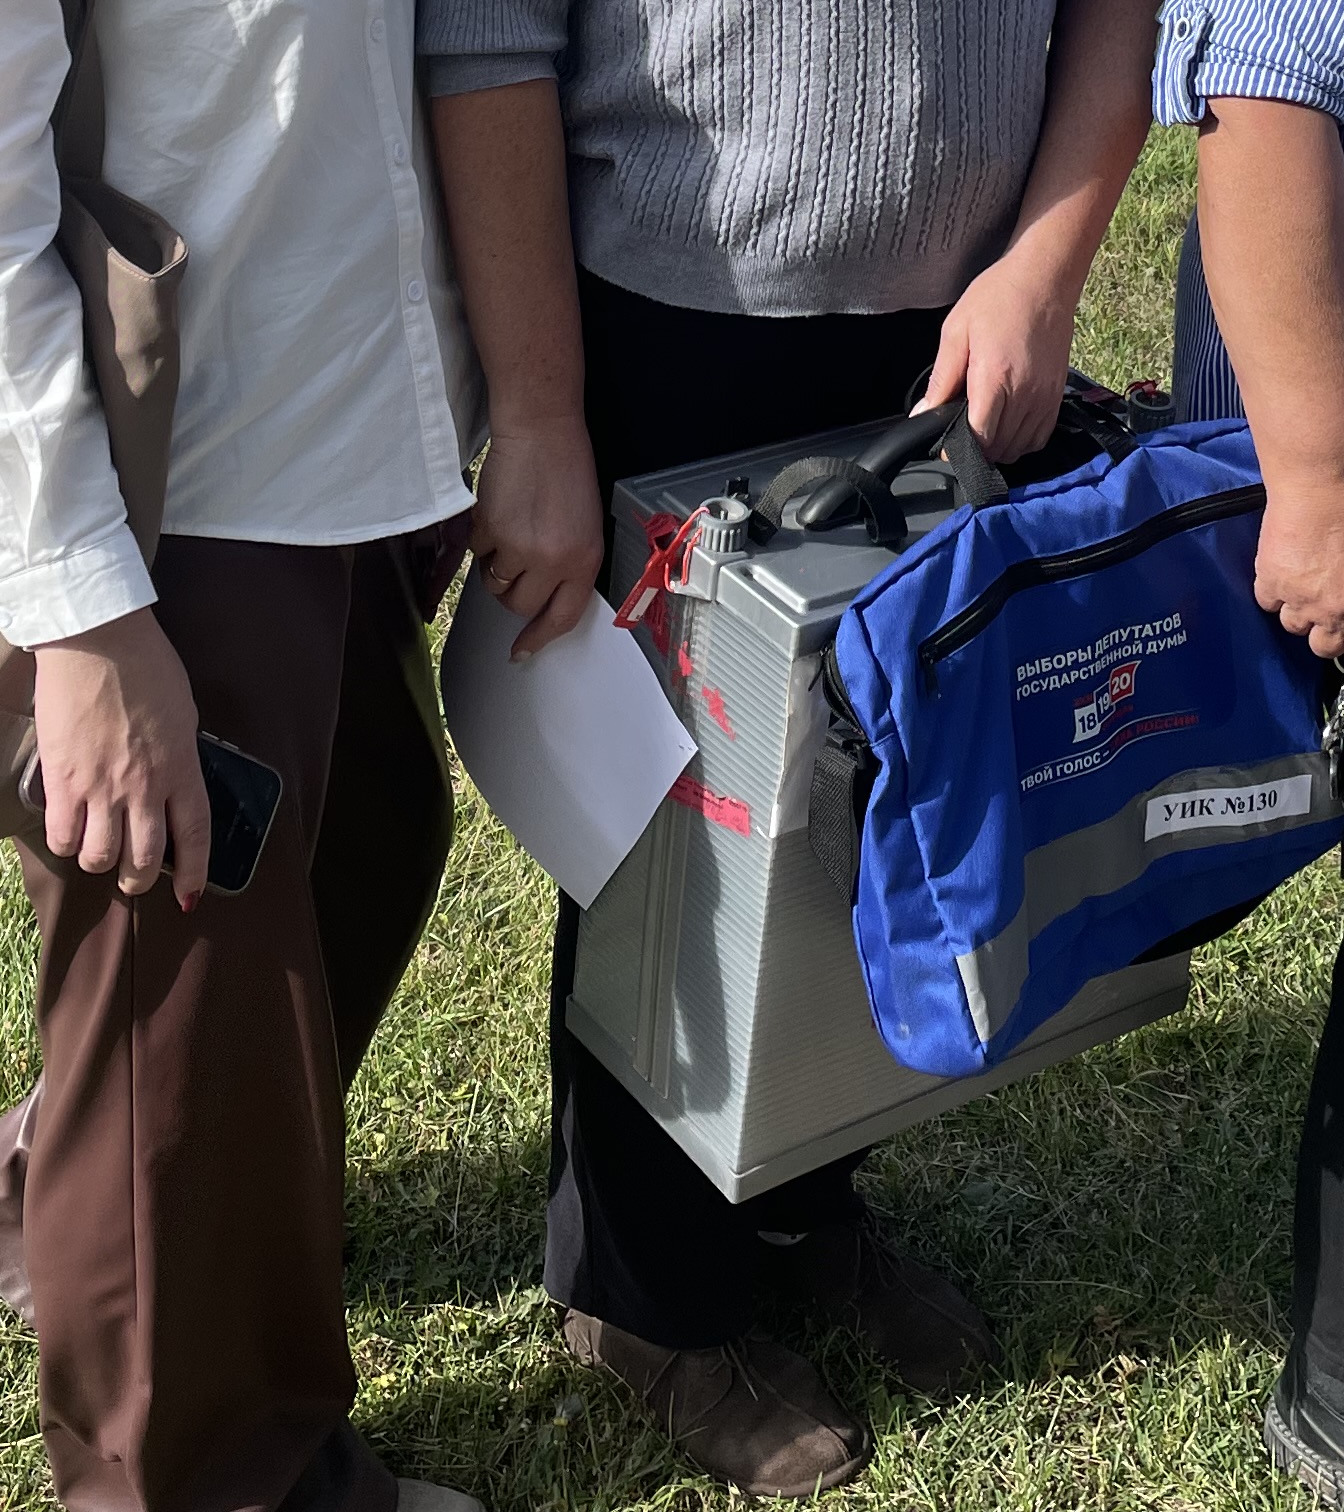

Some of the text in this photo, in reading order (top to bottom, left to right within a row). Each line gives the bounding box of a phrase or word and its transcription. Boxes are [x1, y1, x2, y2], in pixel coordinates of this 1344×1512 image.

[1016, 612, 1182, 682] ВЫБОРЫ ДЕПУТАТОВ
[1016, 629, 1187, 701] ГОСУДАРСТВЕННОЙ ДУМЫ
[1078, 713, 1097, 734] 18
[1097, 692, 1110, 714] 19
[1111, 672, 1130, 695] 20
[1020, 765, 1053, 791] ТВОЙ
[1056, 751, 1101, 777] ГОЛОС
[1163, 789, 1278, 822] УИК №130
